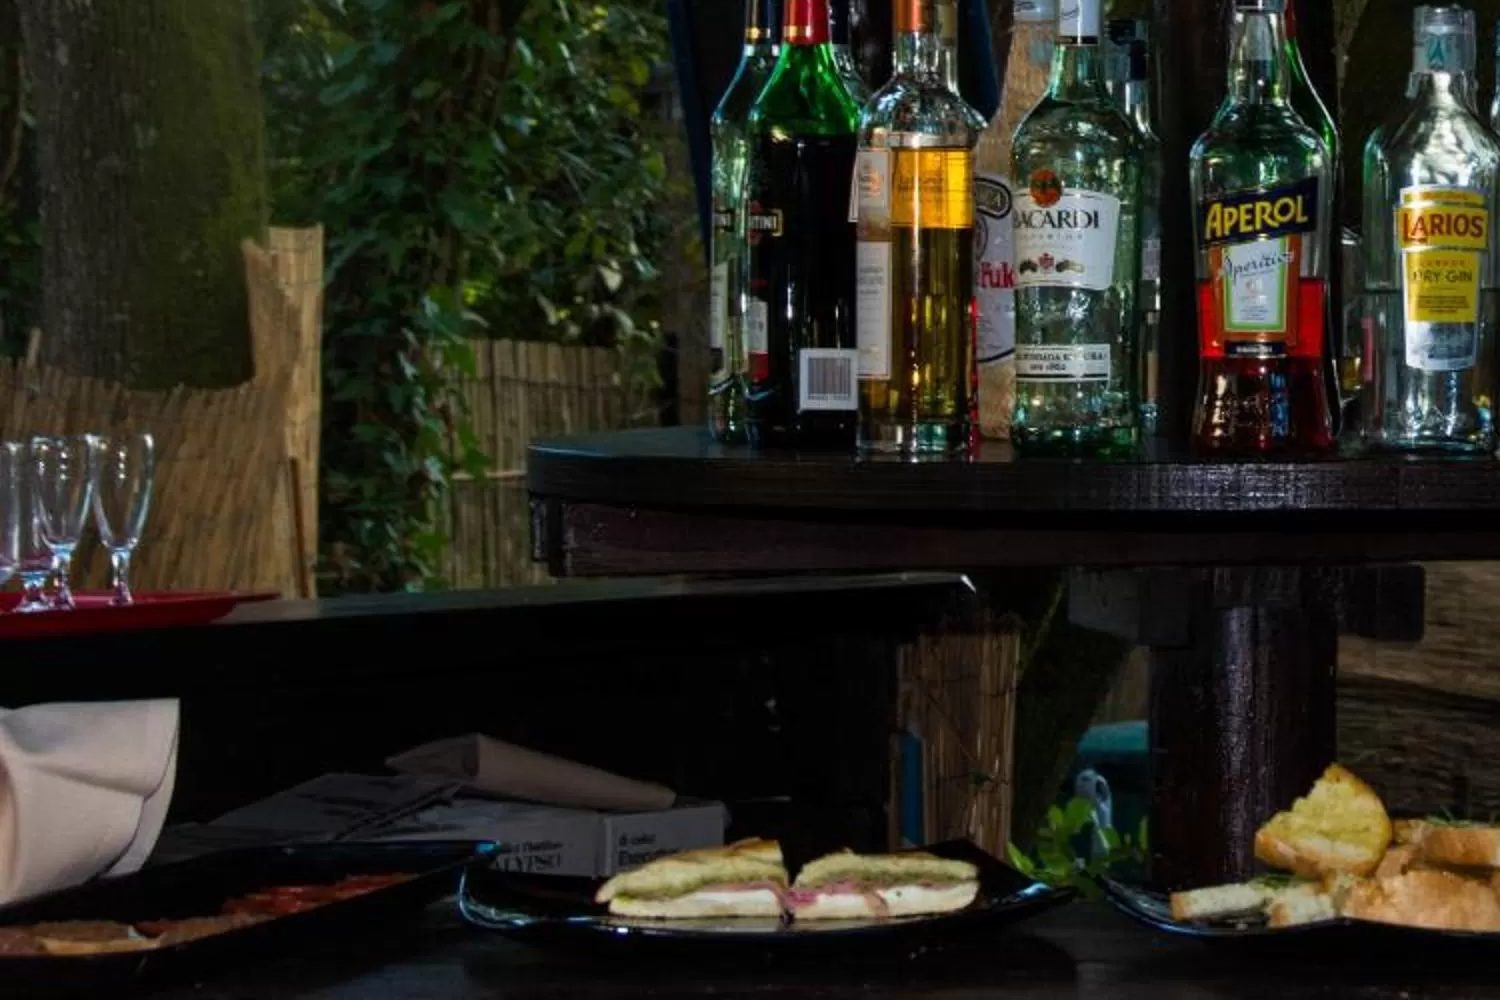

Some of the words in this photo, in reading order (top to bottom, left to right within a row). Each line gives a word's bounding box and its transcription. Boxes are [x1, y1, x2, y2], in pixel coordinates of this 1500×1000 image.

[1014, 209, 1099, 229] BACARDI
[1204, 193, 1310, 242] APEROL
[1402, 212, 1485, 243] LARIOS
